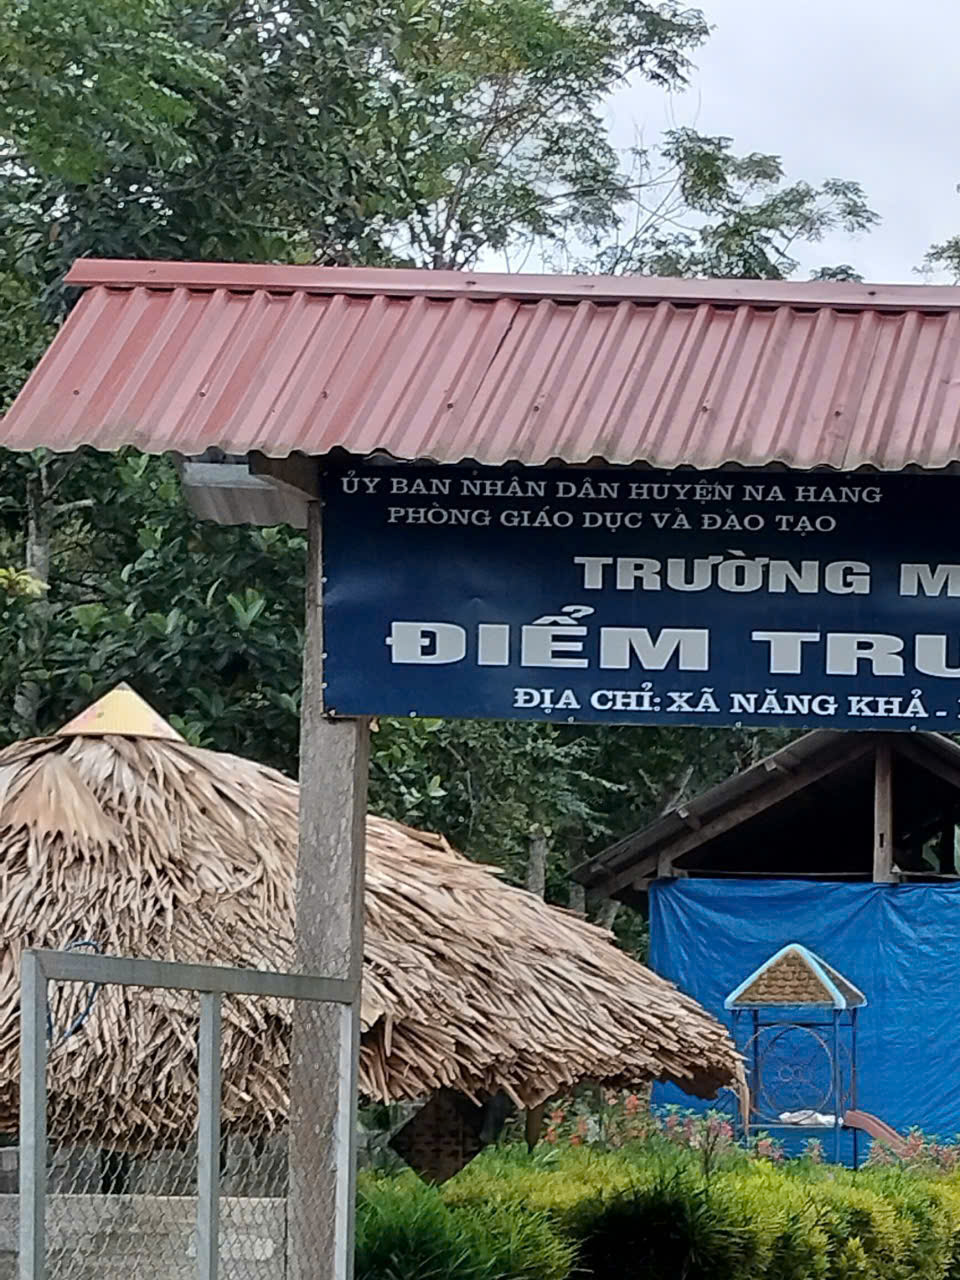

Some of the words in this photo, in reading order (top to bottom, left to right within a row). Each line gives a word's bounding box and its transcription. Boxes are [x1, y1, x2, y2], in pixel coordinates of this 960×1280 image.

[341, 470, 381, 494] ỦY
[390, 478, 451, 495] BAN
[460, 476, 546, 497] NHÂN
[555, 477, 620, 499] DÂN
[628, 479, 733, 505] HUYỆN
[742, 485, 786, 501] NA
[795, 486, 883, 503] HANG
[387, 502, 492, 526] PHÒNG
[500, 506, 574, 528] GIÁO
[582, 511, 643, 532] DỤC
[651, 507, 692, 529] VÀ
[701, 509, 764, 531] ĐÀO
[776, 515, 836, 536] TẠO
[574, 550, 871, 594] TRƯỜNG
[385, 605, 709, 671] ĐIỂM
[513, 688, 581, 713] ĐỊA
[666, 688, 720, 712] XÃ
[729, 689, 838, 715] NĂNG
[847, 689, 929, 718] KHẢ
